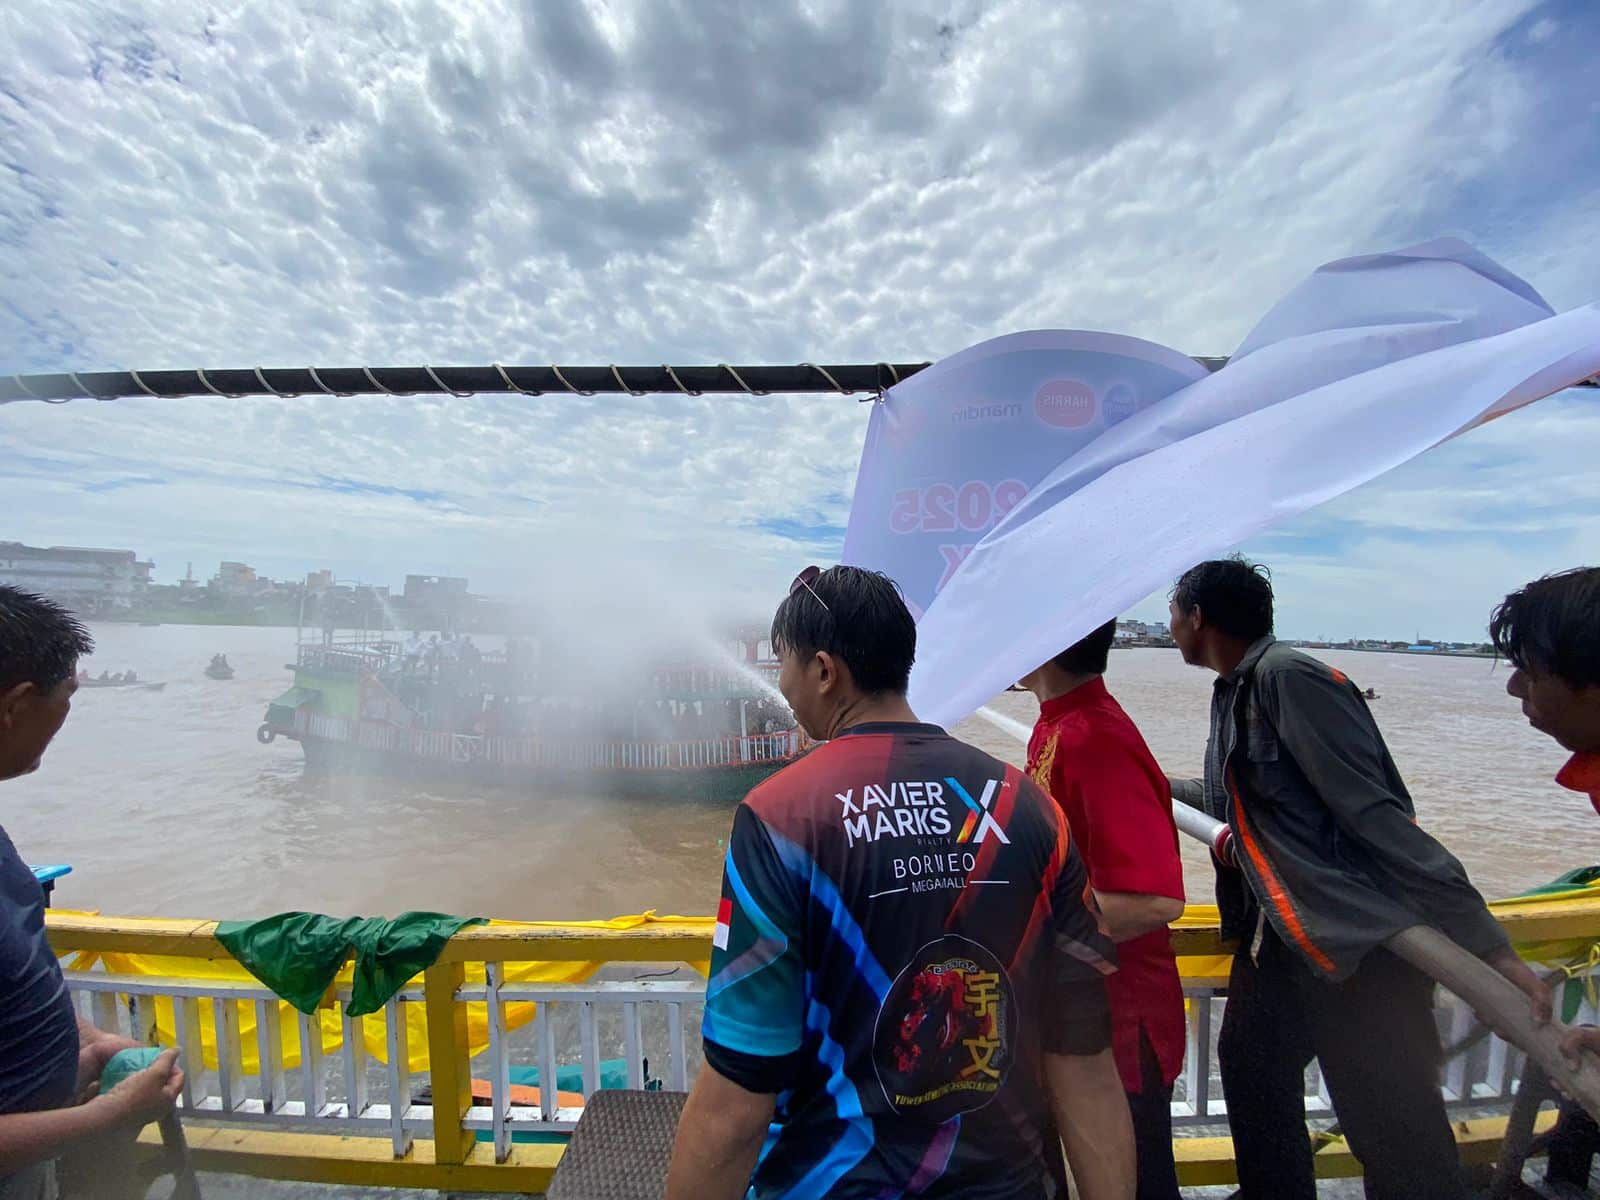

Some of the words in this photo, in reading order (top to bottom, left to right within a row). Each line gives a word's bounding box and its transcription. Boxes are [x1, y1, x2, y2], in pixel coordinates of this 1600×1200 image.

[835, 781, 946, 818] XAVIER
[843, 807, 951, 849] MARKS
[893, 852, 976, 879] BORNEO
[911, 876, 968, 894] MEGAMALL
